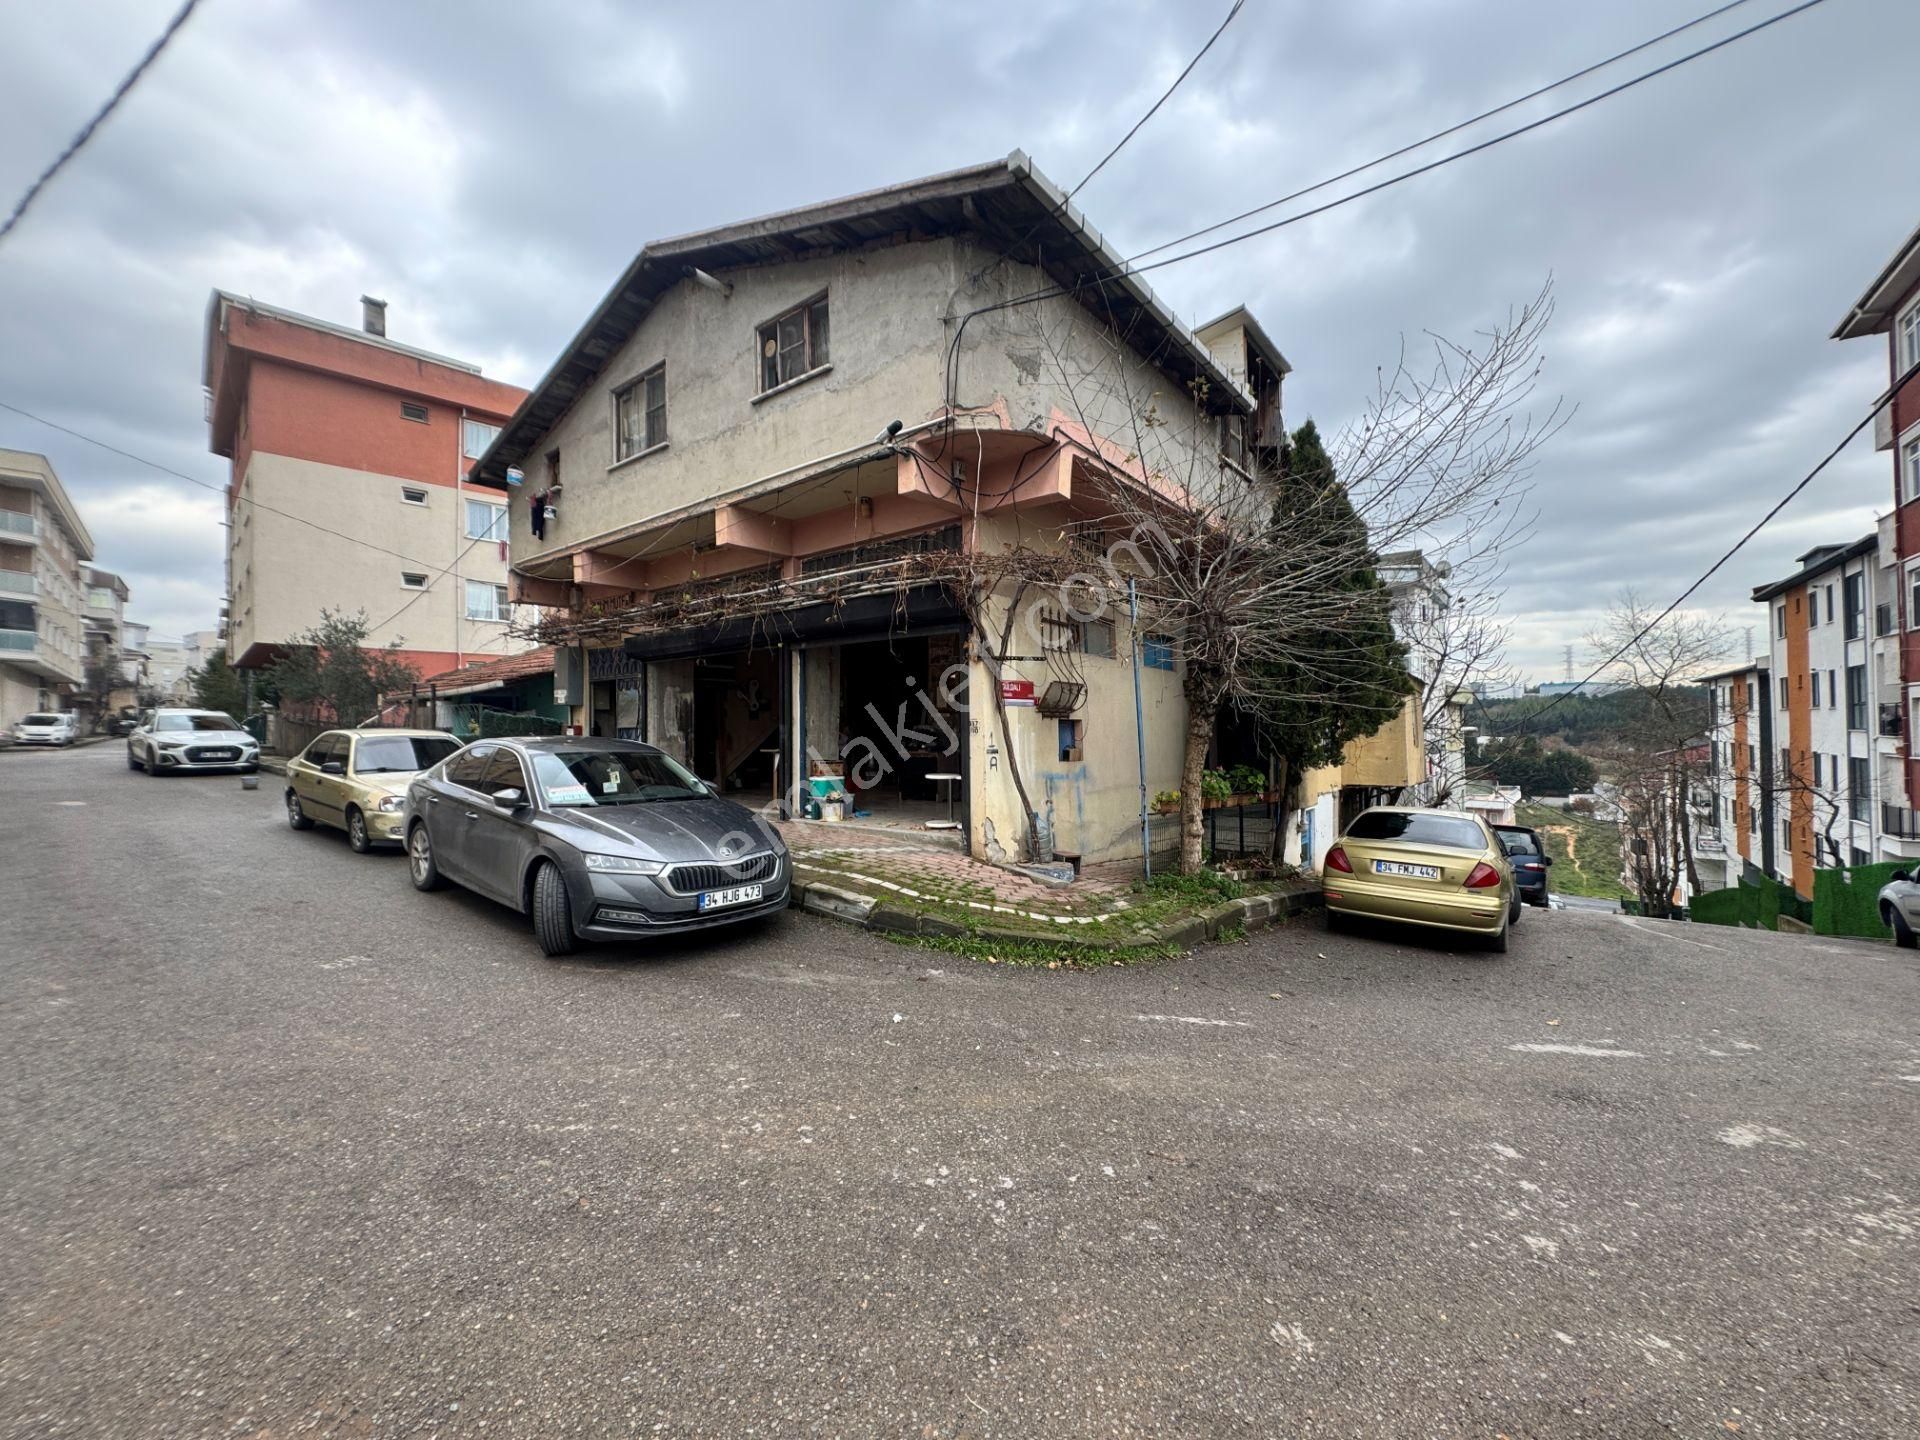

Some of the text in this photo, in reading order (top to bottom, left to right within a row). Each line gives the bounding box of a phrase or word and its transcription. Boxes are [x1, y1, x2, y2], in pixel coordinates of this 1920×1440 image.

[989, 756, 998, 772] A
[1382, 862, 1436, 878] 34 FMJ 442
[705, 886, 761, 907] 34 HJG 473
